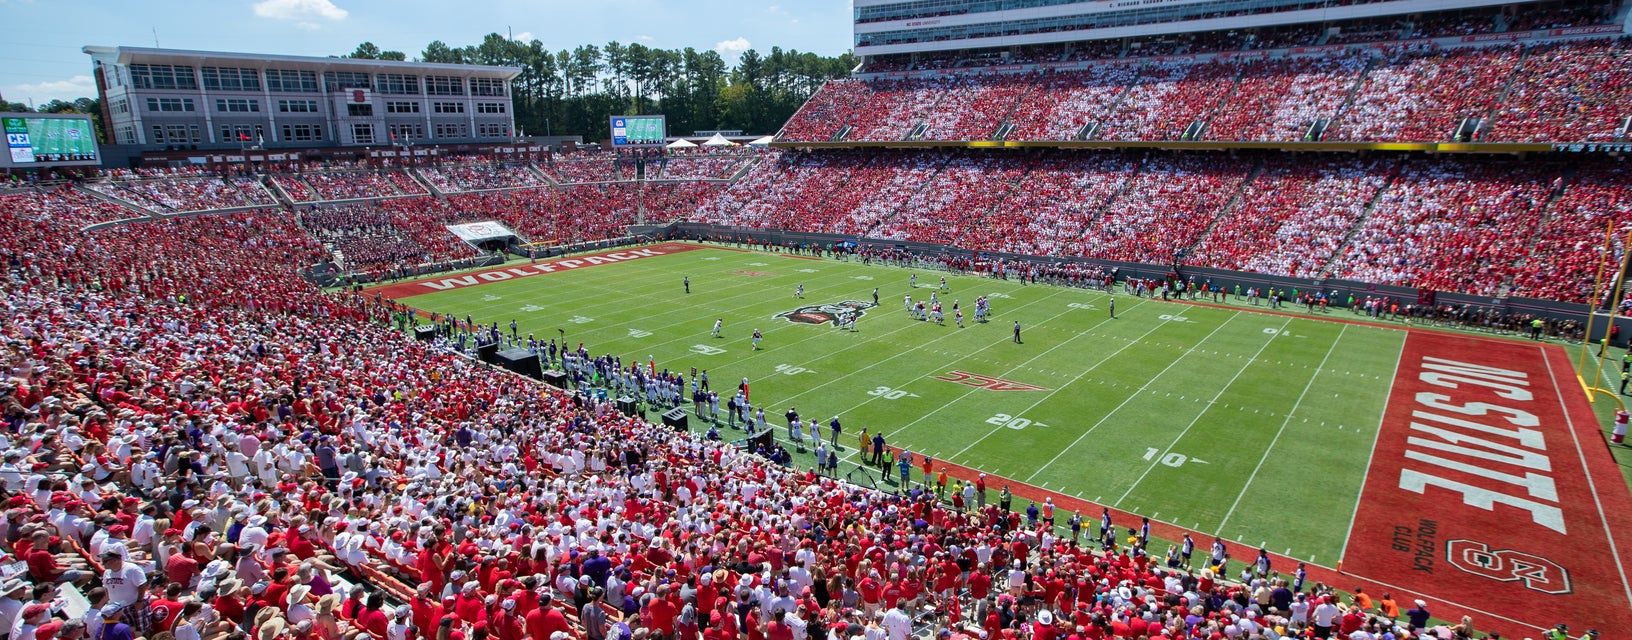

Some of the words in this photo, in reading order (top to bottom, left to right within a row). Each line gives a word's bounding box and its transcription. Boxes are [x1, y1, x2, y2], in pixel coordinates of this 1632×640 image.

[418, 249, 666, 291] WOLFPACK
[775, 363, 806, 375] 40
[927, 370, 1055, 391] ACC
[1419, 356, 1534, 401] NC
[867, 386, 907, 400] 30
[985, 413, 1032, 430] 20
[1142, 447, 1188, 467] 10
[1398, 392, 1567, 535] STATE
[1391, 525, 1412, 552] CLUB
[1412, 519, 1437, 574] WOLFPACK
